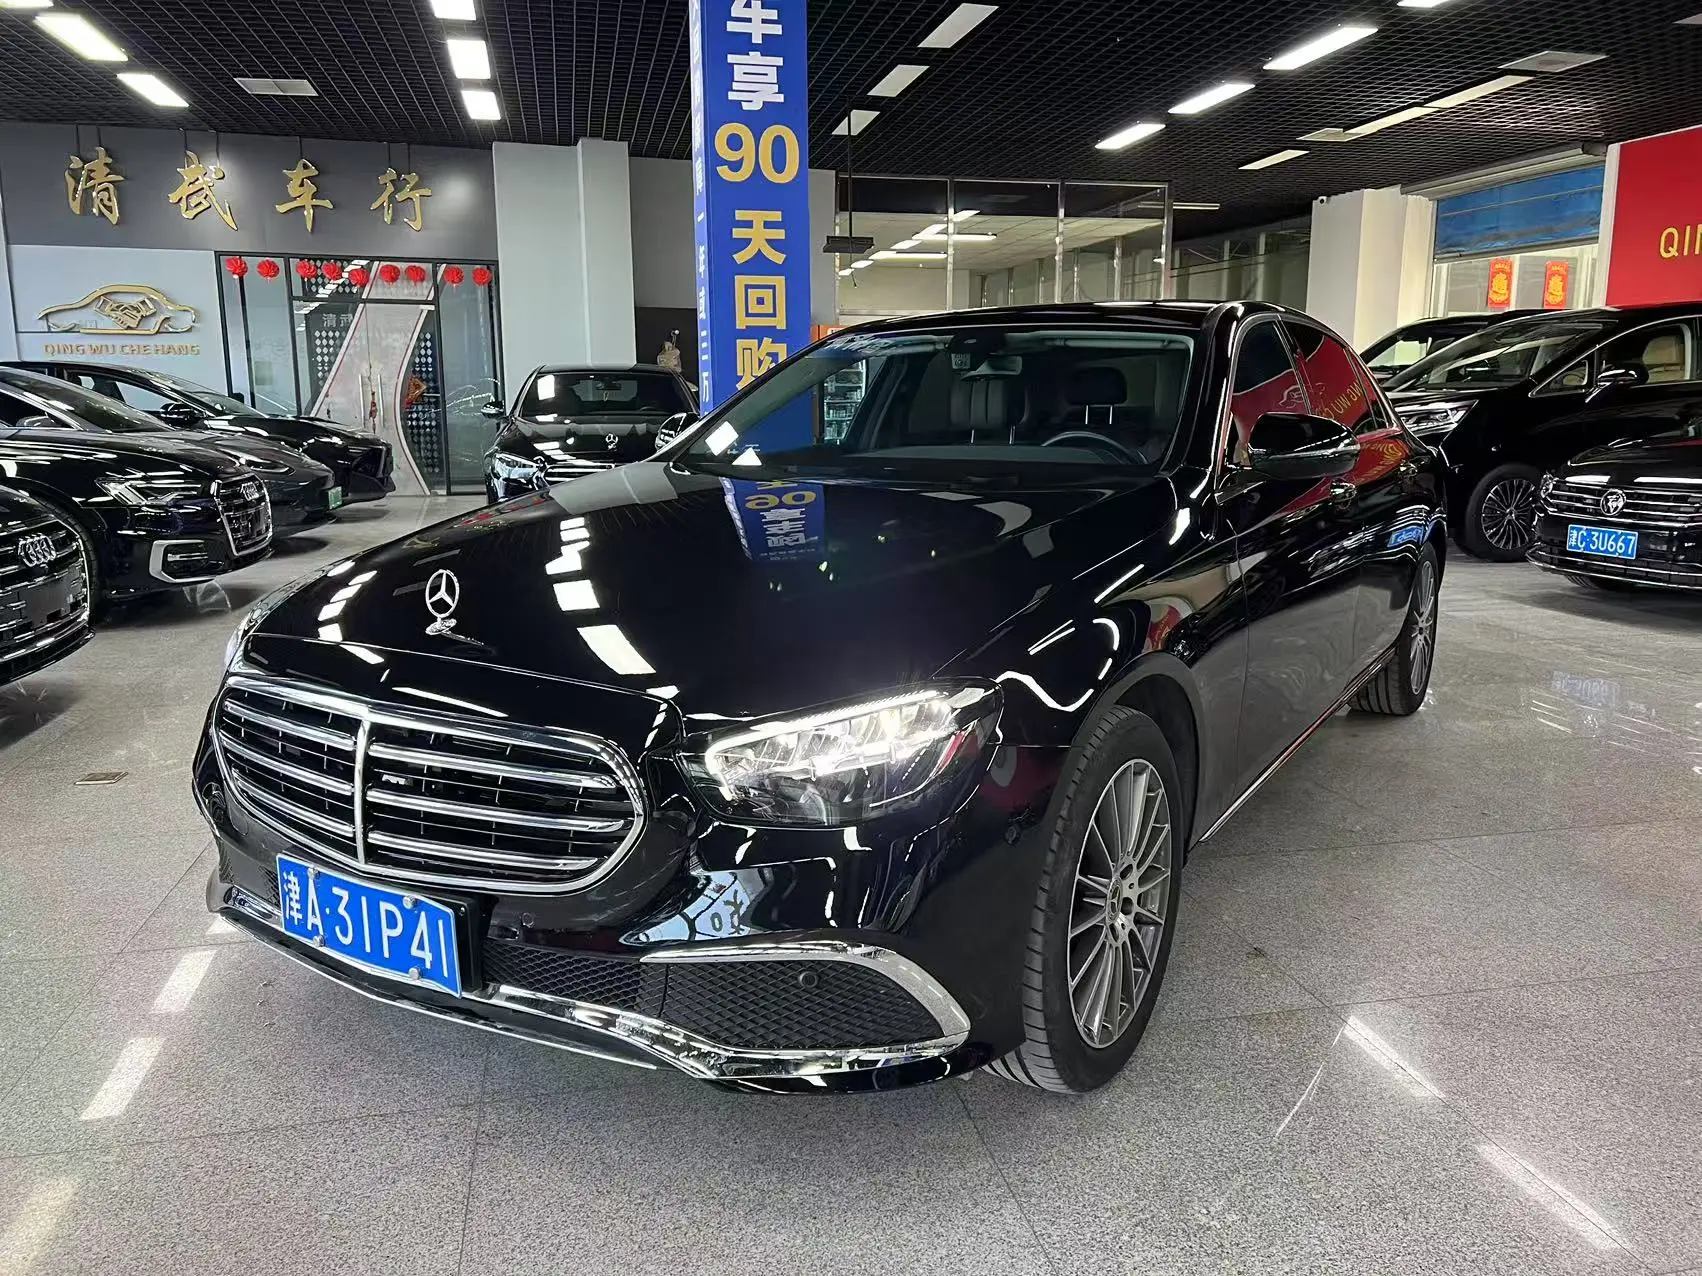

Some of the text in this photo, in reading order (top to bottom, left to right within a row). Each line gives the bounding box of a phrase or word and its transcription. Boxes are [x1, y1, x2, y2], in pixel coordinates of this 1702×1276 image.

[44, 344, 200, 356] QING WU CHE HANG
